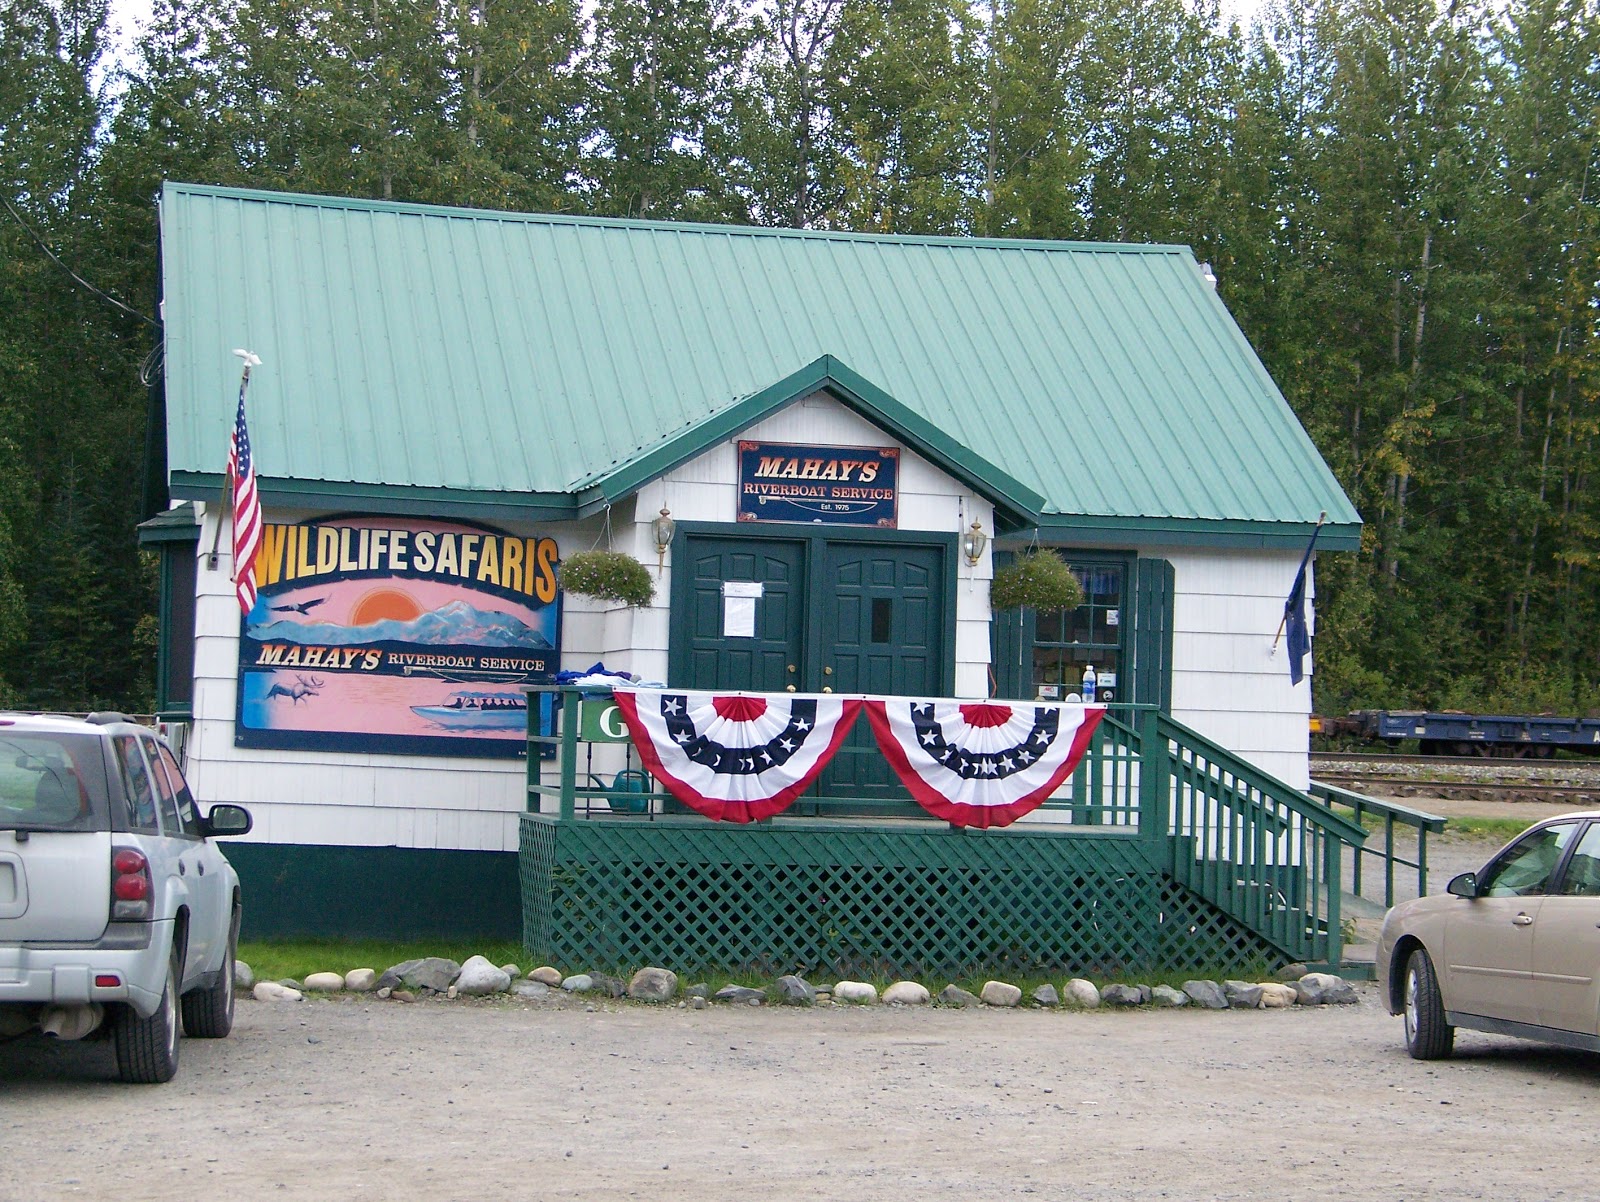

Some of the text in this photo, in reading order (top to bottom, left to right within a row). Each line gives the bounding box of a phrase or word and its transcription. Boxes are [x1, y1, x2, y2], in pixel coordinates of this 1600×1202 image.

[754, 456, 880, 483] MAHAY'S
[744, 483, 893, 500] RIVERBOAT SERVICE
[820, 503, 850, 511] Est. 1975
[254, 524, 558, 604] WILDLIFE SAFARIS
[256, 644, 545, 672] MAHAY'S RIVERBOAT SERVICE
